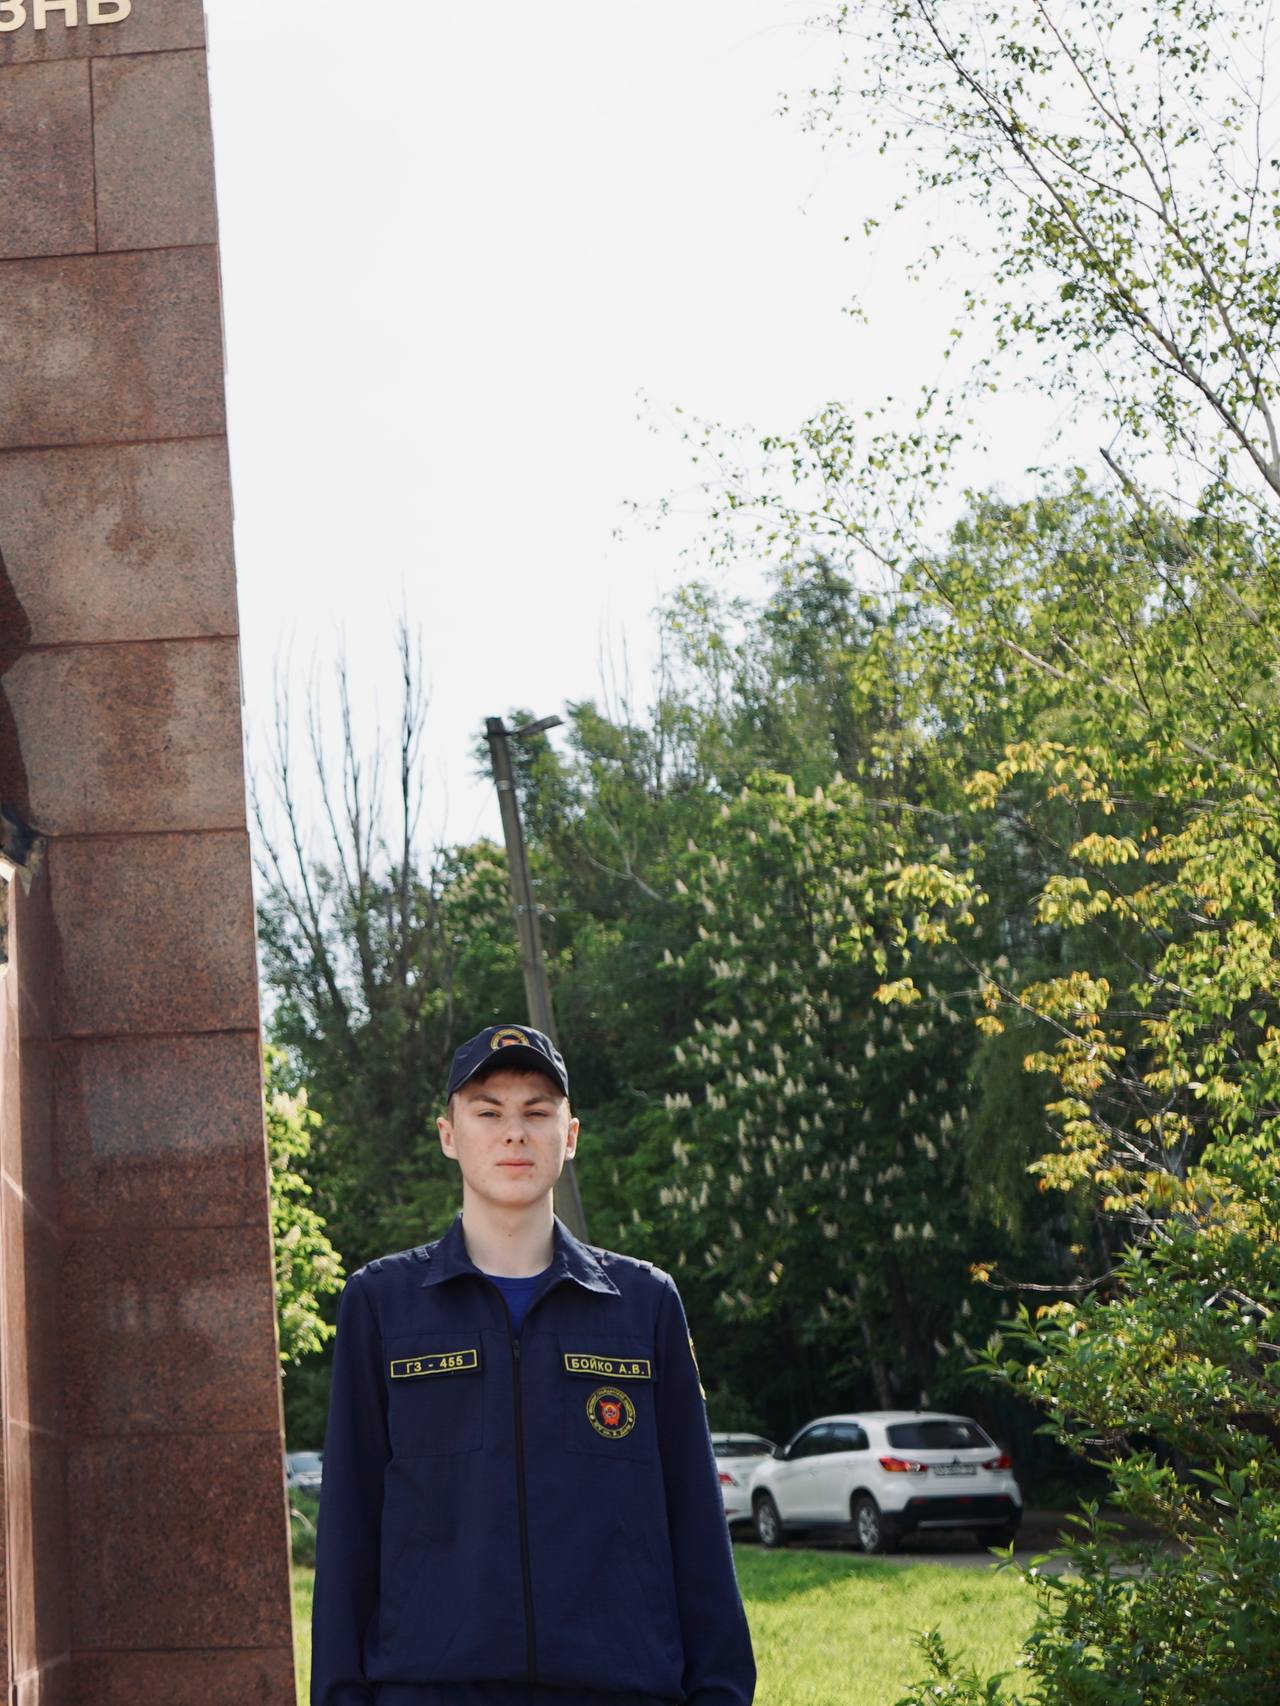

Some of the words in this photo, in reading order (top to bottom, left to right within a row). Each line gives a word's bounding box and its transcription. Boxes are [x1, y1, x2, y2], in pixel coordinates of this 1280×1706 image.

[440, 1355, 463, 1368] 455
[571, 1358, 613, 1373] БОЙКО
[619, 1363, 645, 1375] А.В.
